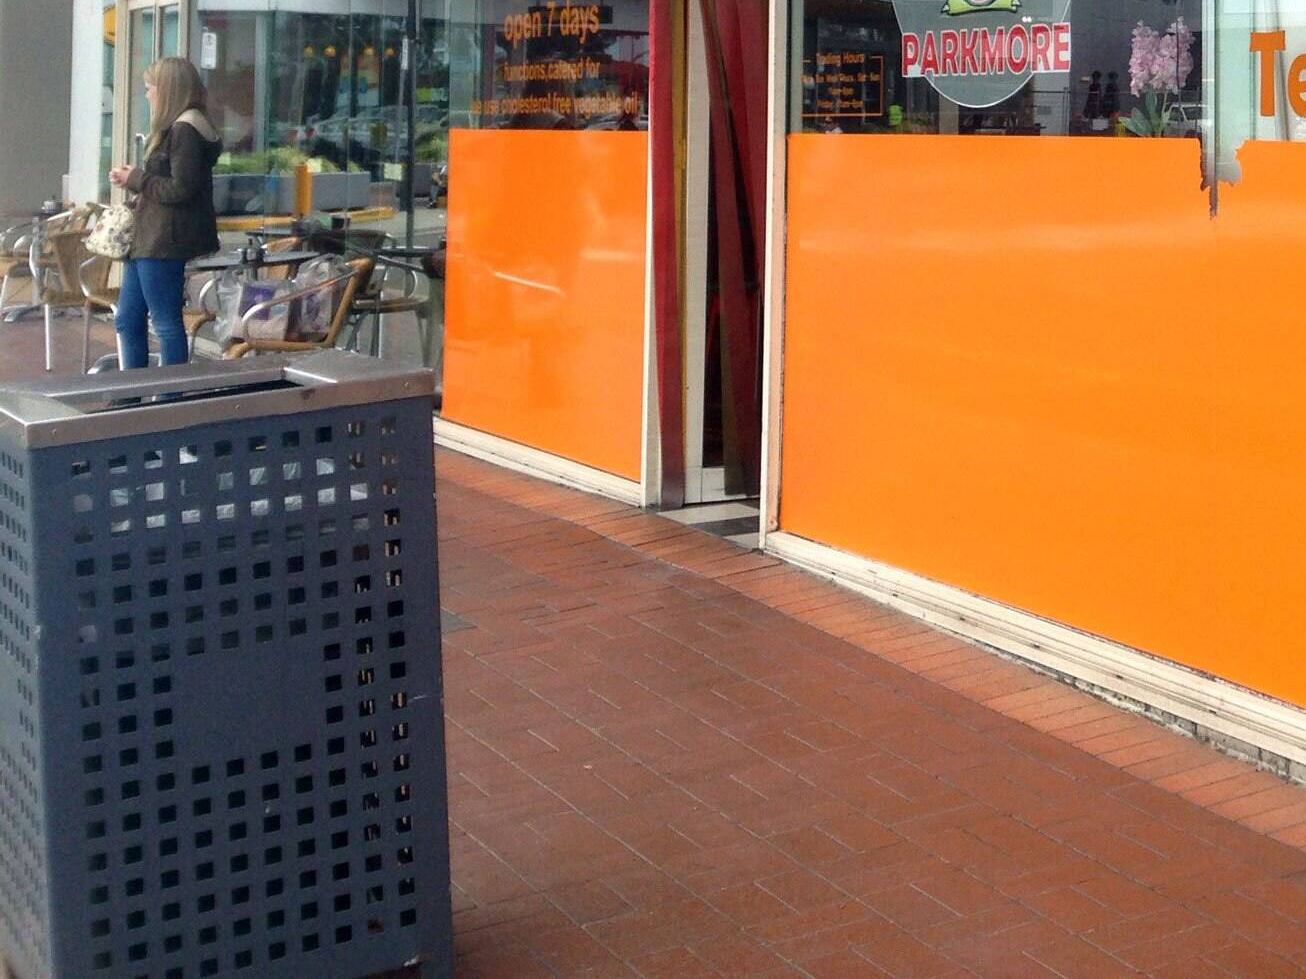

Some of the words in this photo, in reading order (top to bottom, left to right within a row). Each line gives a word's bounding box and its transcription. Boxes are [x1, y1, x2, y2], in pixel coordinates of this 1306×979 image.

[504, 8, 541, 50] open
[547, 0, 556, 37] 7
[901, 22, 1072, 78] PARKMORE
[553, 92, 571, 114] free
